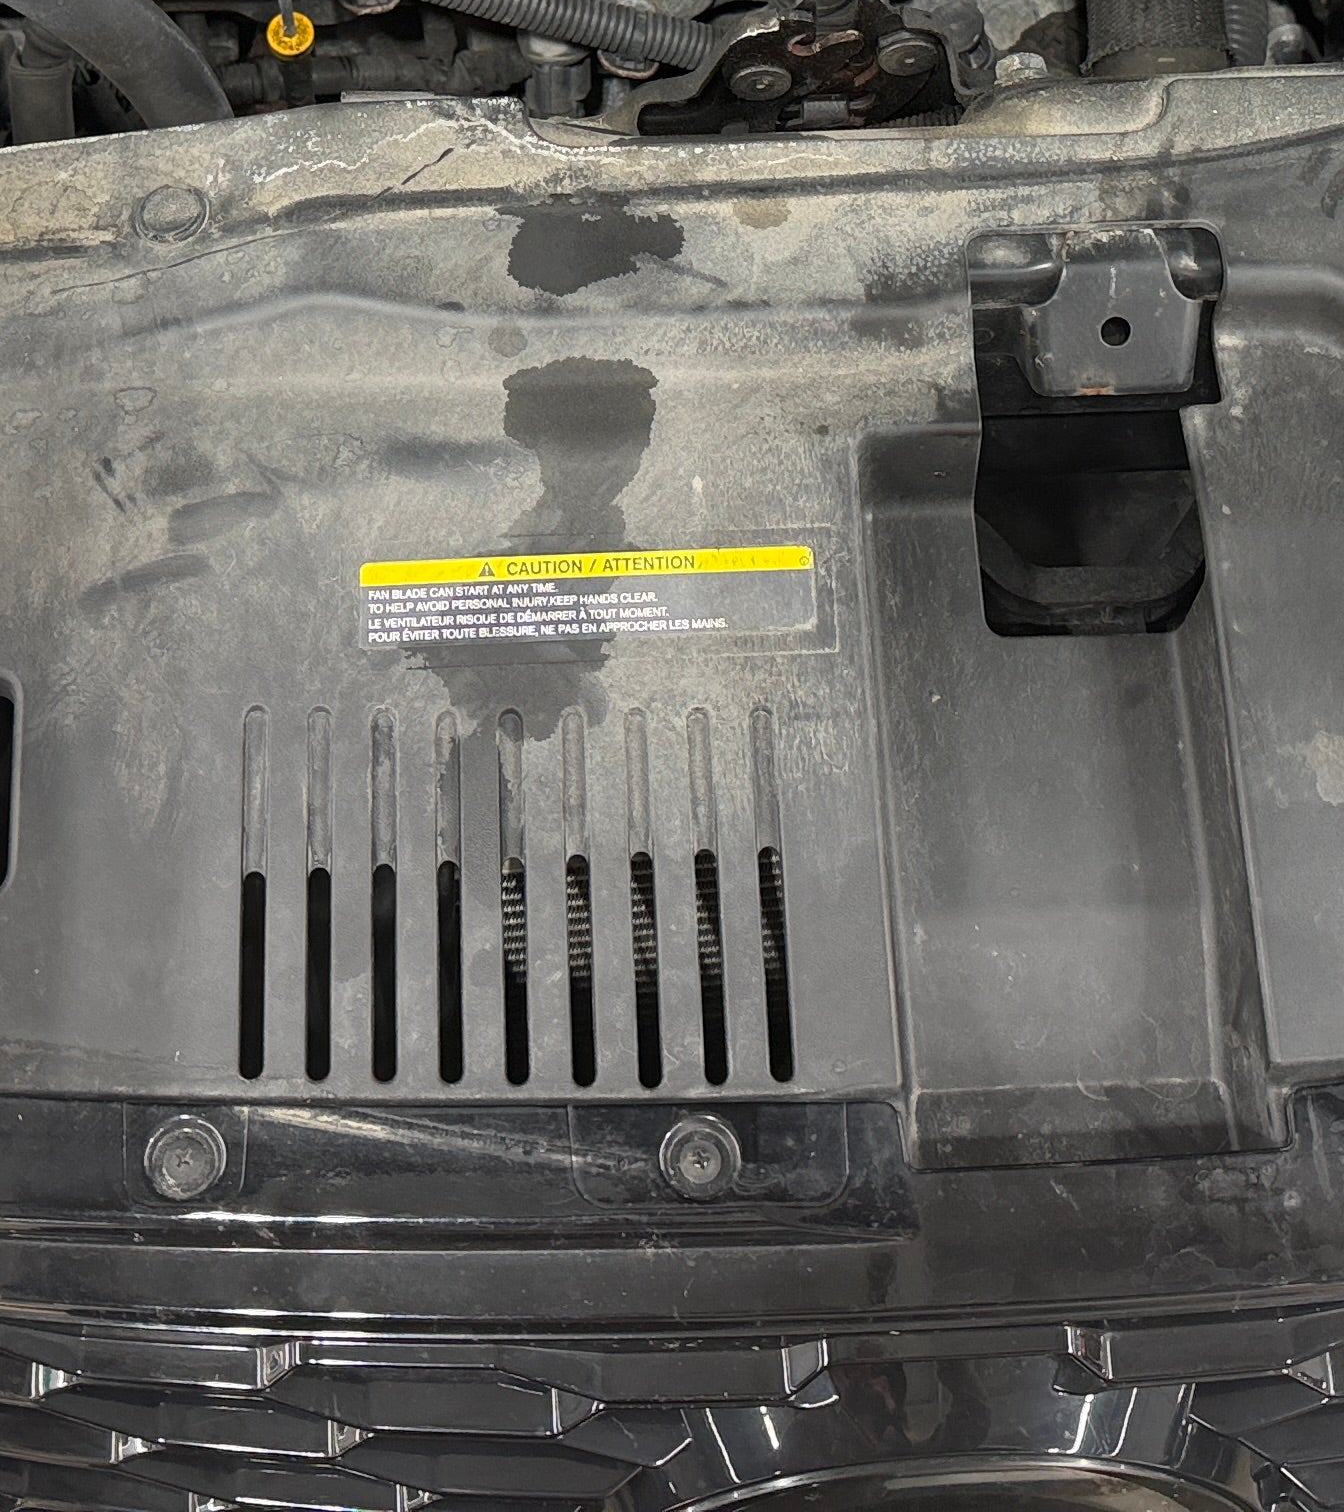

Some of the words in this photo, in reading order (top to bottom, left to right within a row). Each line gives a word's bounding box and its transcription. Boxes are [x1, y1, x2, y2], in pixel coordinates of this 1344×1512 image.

[506, 560, 583, 576] CAUTION
[602, 555, 695, 573] ATTENTION
[368, 590, 390, 601] FAN
[391, 588, 427, 600] BLADE
[429, 587, 453, 598] CAN
[455, 585, 490, 597] START
[491, 584, 505, 595] AT
[506, 583, 530, 595] ANY
[530, 582, 559, 594] TIME.
[368, 603, 383, 614] TO
[385, 601, 414, 613] HELP
[416, 600, 449, 612] AVOID
[451, 598, 510, 610] PERSONAL
[579, 593, 617, 605] HANDS
[619, 591, 658, 603] CLEAR.
[368, 618, 382, 630] LE
[384, 615, 454, 629] VENTILATEUR
[456, 614, 497, 625] RISQUE
[499, 612, 515, 623] DE
[517, 609, 577, 622] DÉMARRER
[578, 606, 588, 620] À
[588, 608, 618, 619] TOUT
[619, 606, 670, 618] MOMENT.
[368, 631, 401, 643] POUR
[402, 628, 439, 642] ÉVITER
[441, 628, 477, 639] TOUTE
[478, 624, 539, 638] BLESSURE,
[540, 624, 556, 635] NE
[558, 623, 580, 634] PAS
[581, 622, 597, 633] EN
[598, 619, 667, 633] APPROCHER
[668, 619, 690, 629] LES
[691, 617, 729, 629] MAINS.
